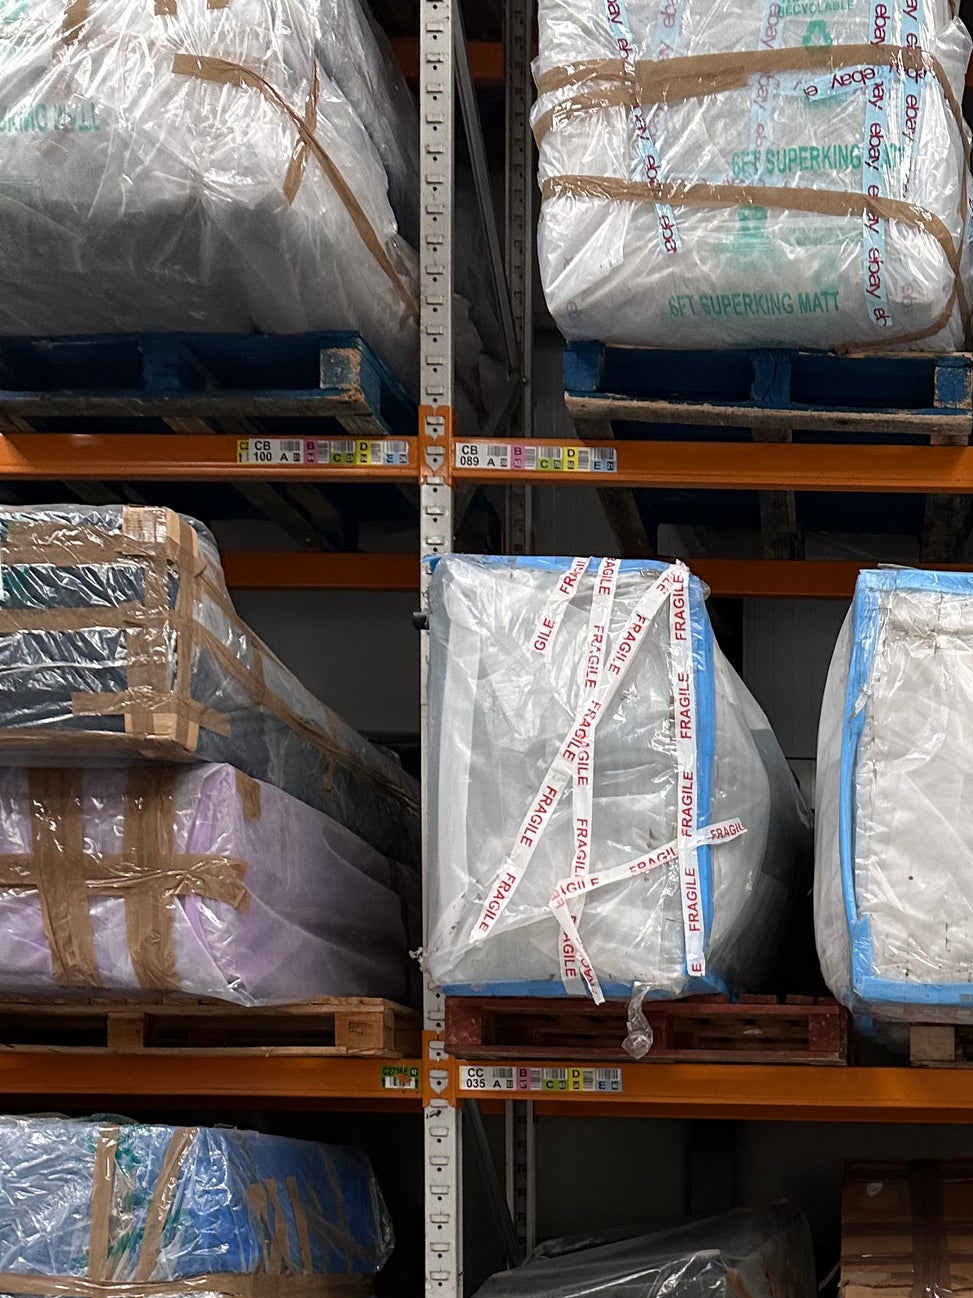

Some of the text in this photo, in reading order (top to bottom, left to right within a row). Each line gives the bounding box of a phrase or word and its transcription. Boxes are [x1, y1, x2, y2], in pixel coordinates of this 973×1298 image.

[831, 66, 876, 89] ebay
[902, 94, 919, 142] ebay
[865, 122, 883, 171] ebay
[766, 143, 861, 175] SUPERKING
[866, 248, 884, 300] ebay
[669, 290, 840, 318] 6FT SUPERKING MATT
[254, 440, 271, 451] CB
[306, 441, 315, 450] B
[360, 441, 368, 451] D
[461, 445, 478, 455] CB
[253, 452, 273, 462] 100
[280, 454, 289, 462] A
[514, 447, 522, 456] B
[567, 448, 576, 458] D
[333, 454, 342, 463] C
[460, 456, 479, 466] 089
[487, 458, 496, 467] A
[540, 459, 549, 469] C
[593, 461, 601, 470] E
[673, 575, 687, 641] FRAGILE
[533, 617, 555, 651] GILE
[584, 624, 605, 689] FRAGILE
[677, 672, 692, 740] FRAGILE
[478, 613, 647, 932] FRAGILE FRAGILE FRAGILE FRAGILE
[681, 770, 694, 838] FRAGILE
[574, 818, 588, 880] FRAGIL
[685, 867, 700, 932] FRAGILE
[467, 1068, 484, 1078] CC
[519, 1069, 527, 1078] B
[572, 1069, 580, 1078] D
[466, 1078, 486, 1089] 035
[492, 1080, 501, 1089] A
[545, 1081, 554, 1090] C
[598, 1081, 606, 1090] E
